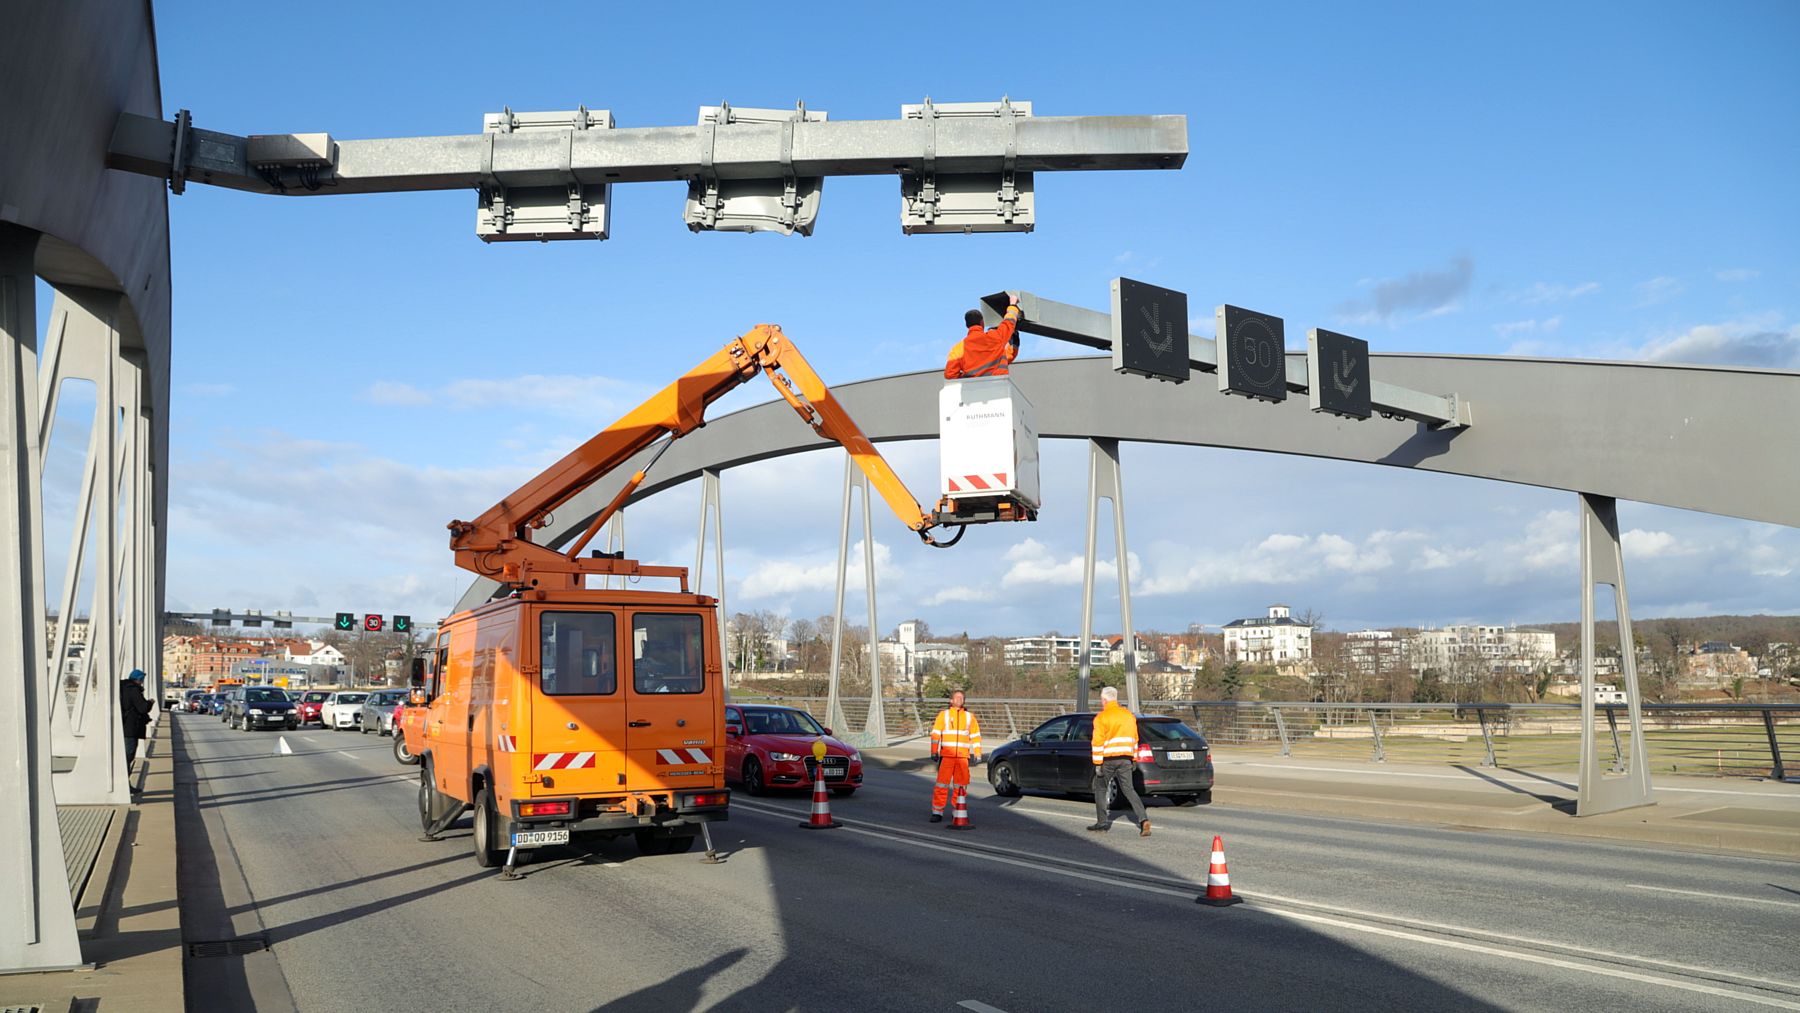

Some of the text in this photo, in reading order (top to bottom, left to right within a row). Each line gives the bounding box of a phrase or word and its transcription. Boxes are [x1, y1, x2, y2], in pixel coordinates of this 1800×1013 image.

[1244, 336, 1270, 367] 50
[368, 618, 379, 627] 30
[517, 834, 529, 843] DD
[547, 831, 568, 841] 9156
